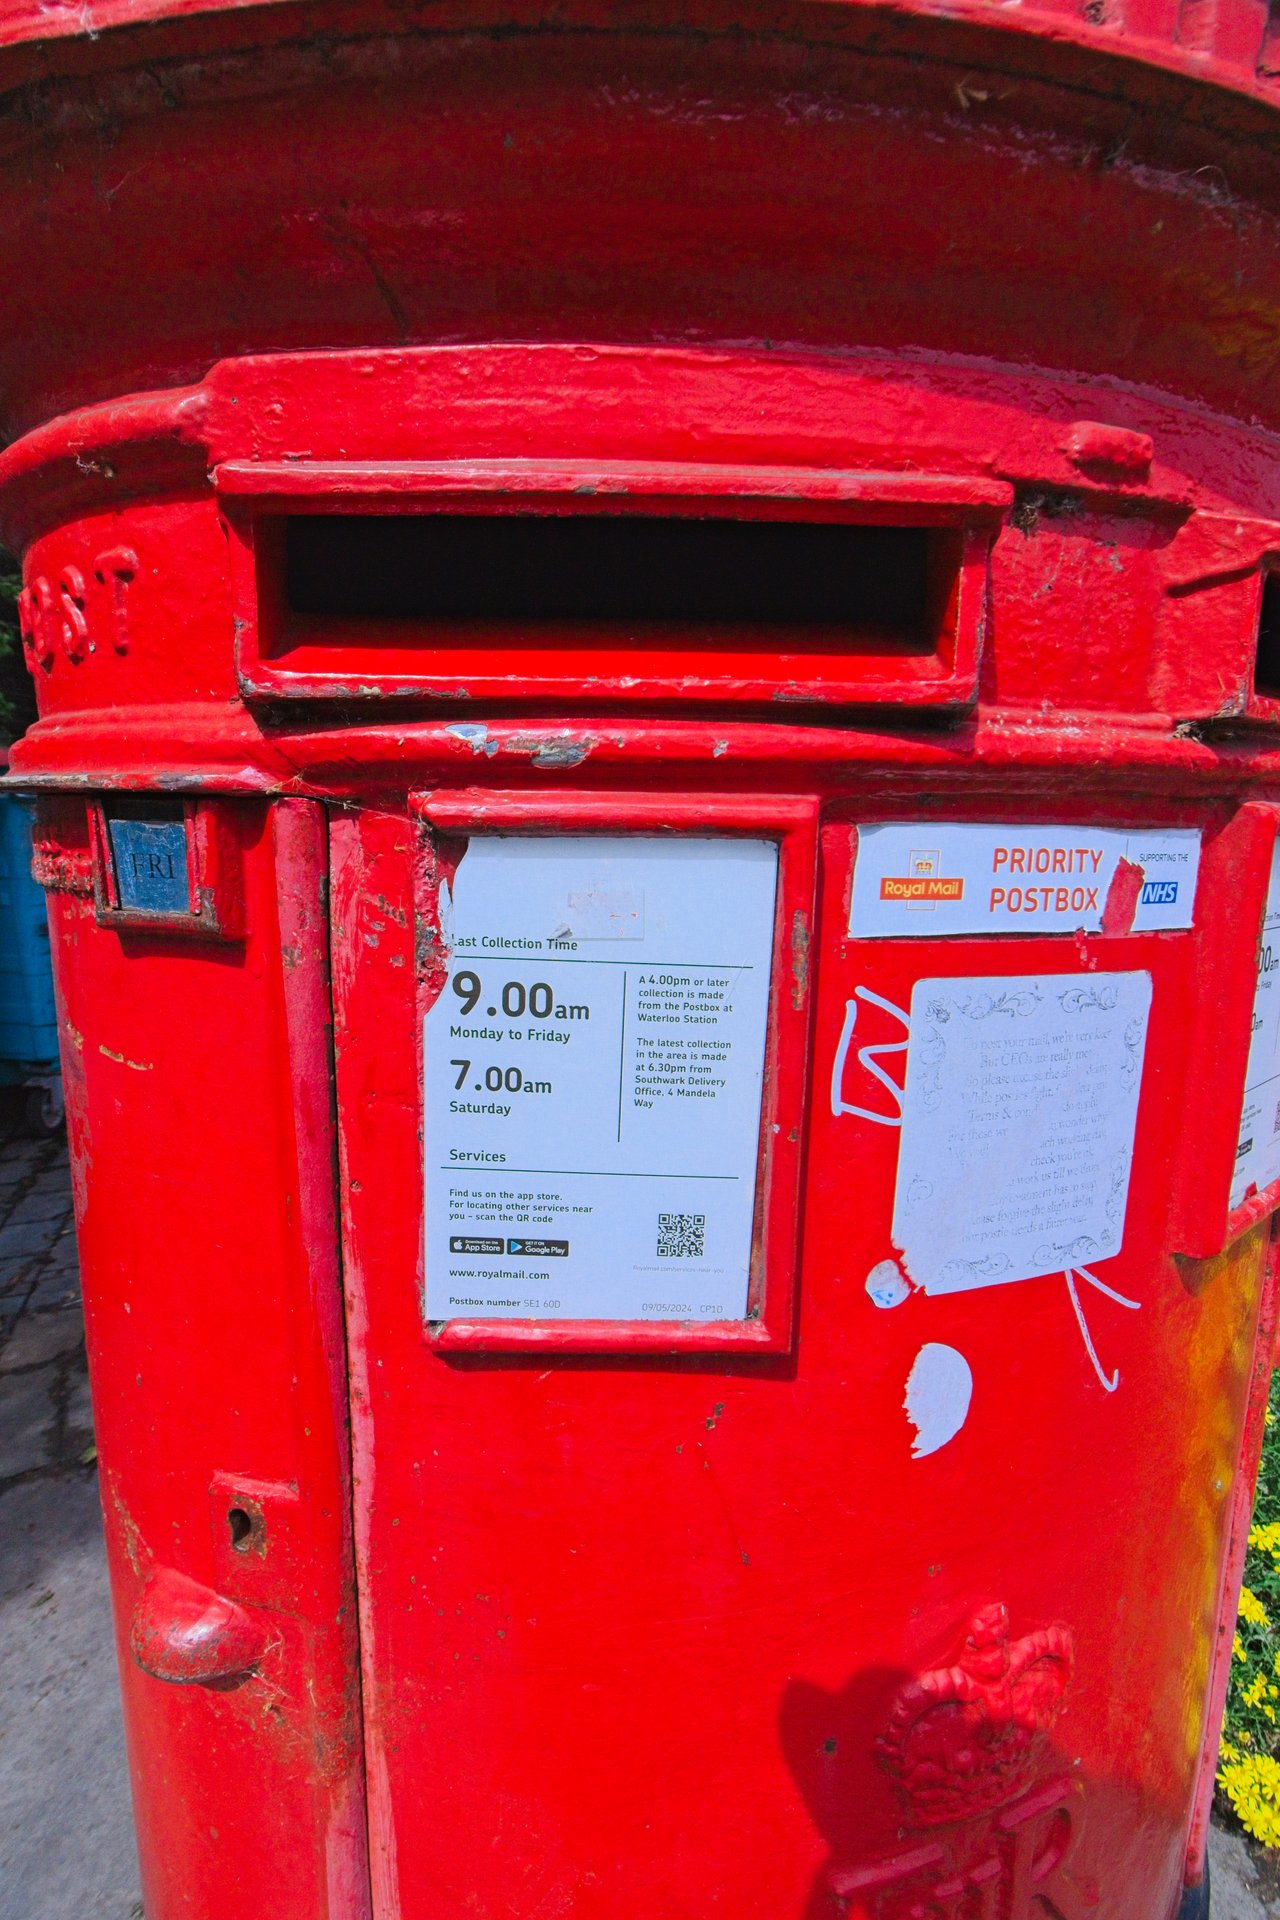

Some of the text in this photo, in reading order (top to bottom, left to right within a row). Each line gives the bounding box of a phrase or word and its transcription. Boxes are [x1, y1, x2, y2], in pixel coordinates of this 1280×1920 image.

[992, 847, 1104, 874] PRIORITY
[1139, 853, 1189, 862] SUPPORTING THE
[133, 854, 175, 880] FRI
[884, 880, 959, 898] Royal Mail
[1142, 883, 1177, 903] NHS
[989, 887, 1100, 913] POSTBOX
[481, 936, 543, 950] Collection
[546, 938, 578, 951] Time
[638, 974, 730, 988] A 4.00pm or later
[452, 970, 590, 1021] 9.00am
[638, 989, 725, 1000] collection is made
[638, 1001, 733, 1012] from the Postbox at
[637, 1013, 718, 1024] Waterloo Station
[450, 1025, 571, 1044] Monday to Friday
[637, 1037, 732, 1049] The latest collection
[636, 1050, 645, 1058] in
[648, 1050, 664, 1059] the
[690, 1052, 698, 1060] is
[701, 1052, 727, 1061] made
[1001, 1051, 1032, 1066] CEOs
[635, 1063, 712, 1074] at 6.30pm from
[450, 1059, 552, 1094] 7.00am
[635, 1075, 726, 1087] Southwark Delivery
[668, 1088, 674, 1097] 4
[676, 1088, 716, 1098] Mandela
[449, 1100, 512, 1117] Saturday
[633, 1099, 654, 1109] Way
[449, 1148, 506, 1162] Services
[450, 1188, 563, 1201] Find us on the app store.
[450, 1200, 593, 1213] For locating other services near
[449, 1213, 465, 1221] you
[499, 1213, 514, 1222] the
[516, 1214, 530, 1222] QR
[532, 1214, 553, 1223] code
[465, 1244, 501, 1252] App Store
[525, 1246, 566, 1255] Google Play
[449, 1269, 550, 1280] www.royalmail.com
[449, 1297, 484, 1306] Postbox
[486, 1298, 522, 1307] number
[523, 1299, 540, 1308] SE1
[642, 1303, 724, 1314] 09/05/2024 CP1D
